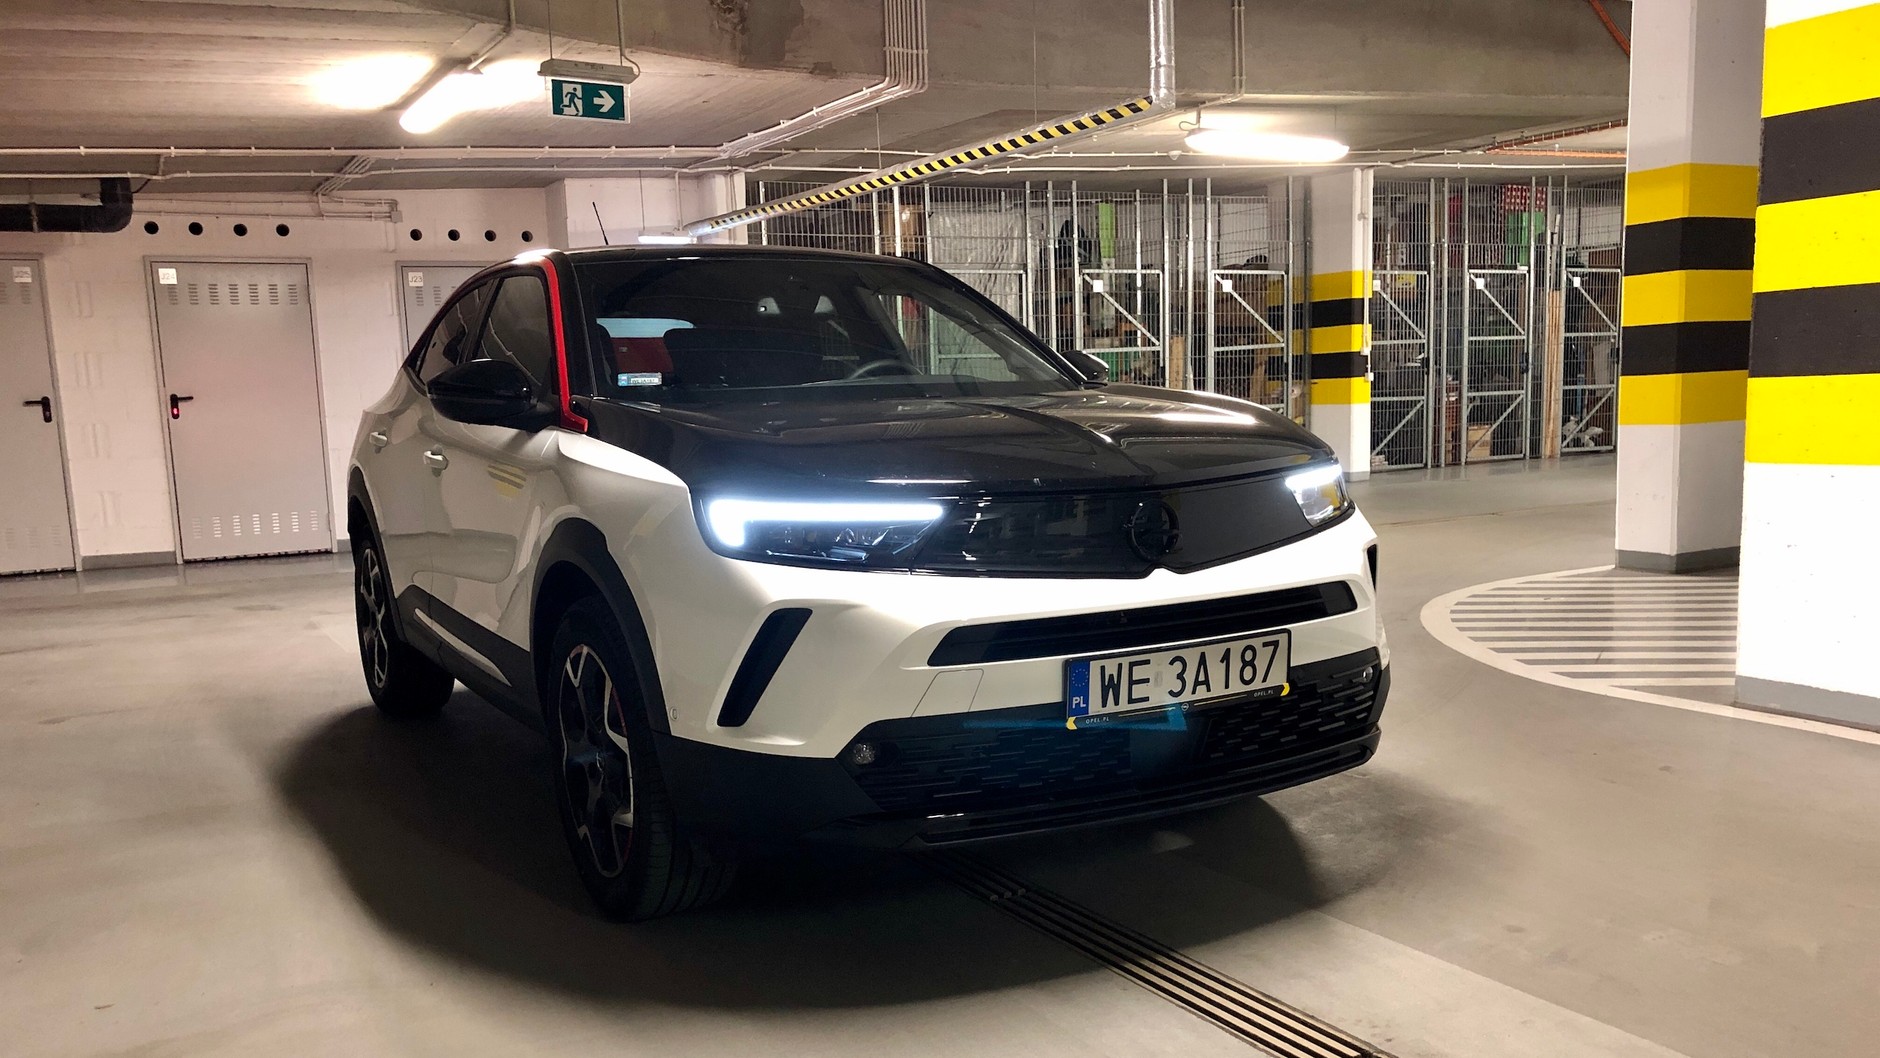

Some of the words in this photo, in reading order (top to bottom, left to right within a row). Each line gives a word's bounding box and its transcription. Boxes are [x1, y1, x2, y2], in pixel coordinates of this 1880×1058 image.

[410, 275, 423, 283] J23
[1100, 659, 1151, 708] WE
[1168, 640, 1280, 698] 3A187
[1072, 695, 1087, 709] PL
